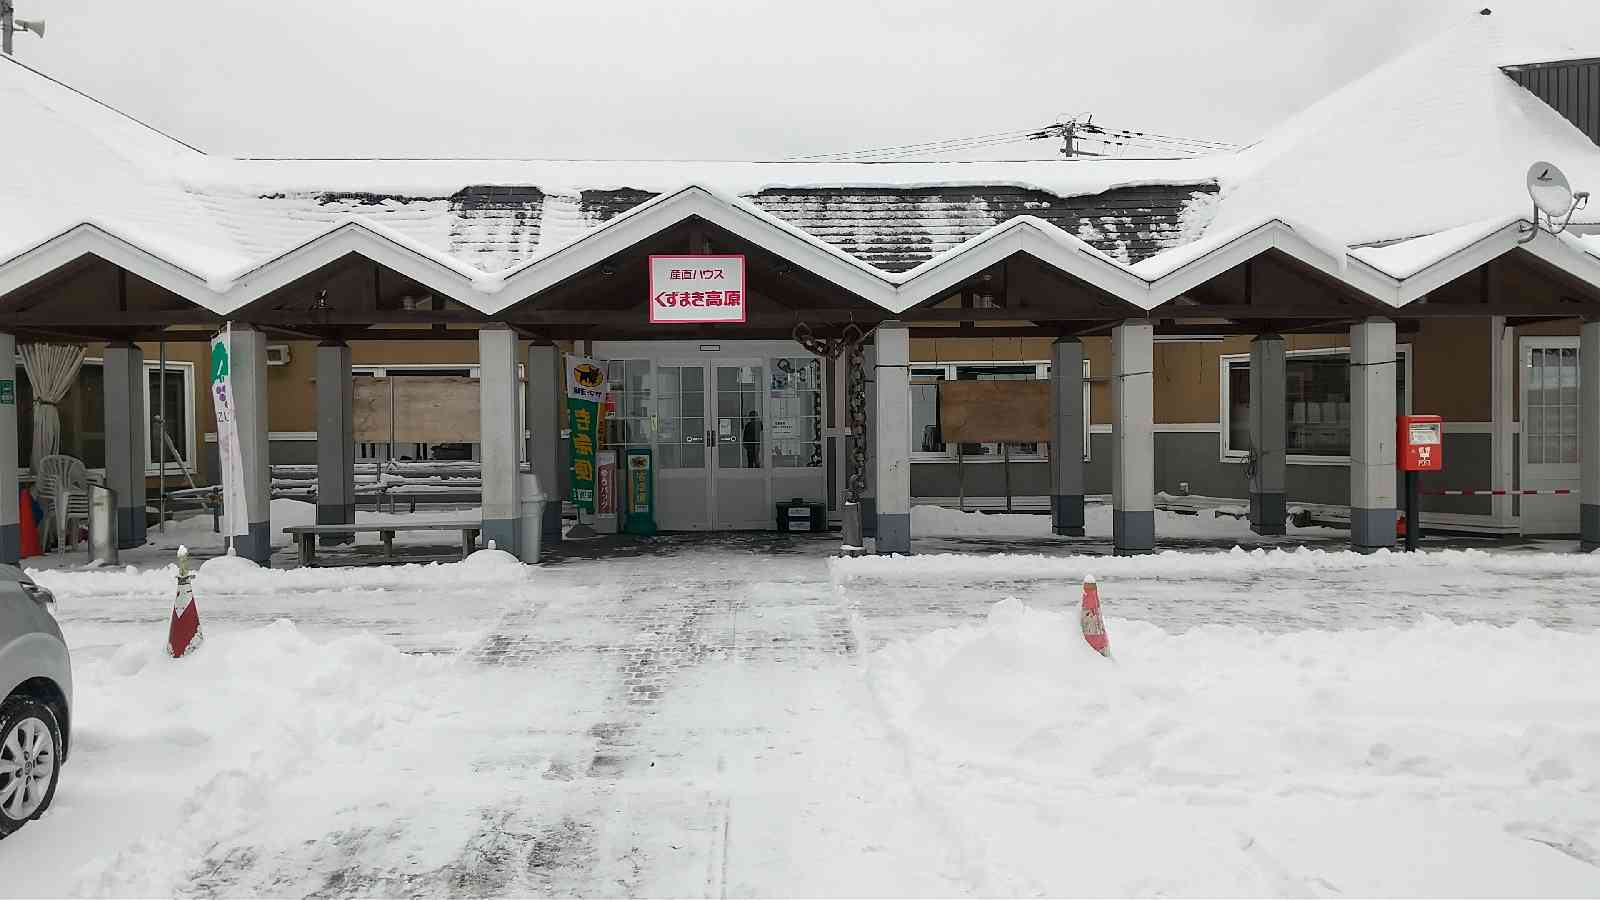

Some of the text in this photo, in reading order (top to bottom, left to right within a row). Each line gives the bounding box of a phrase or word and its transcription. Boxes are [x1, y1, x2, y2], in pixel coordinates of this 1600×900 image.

[670, 269, 724, 280] 産直ハウス
